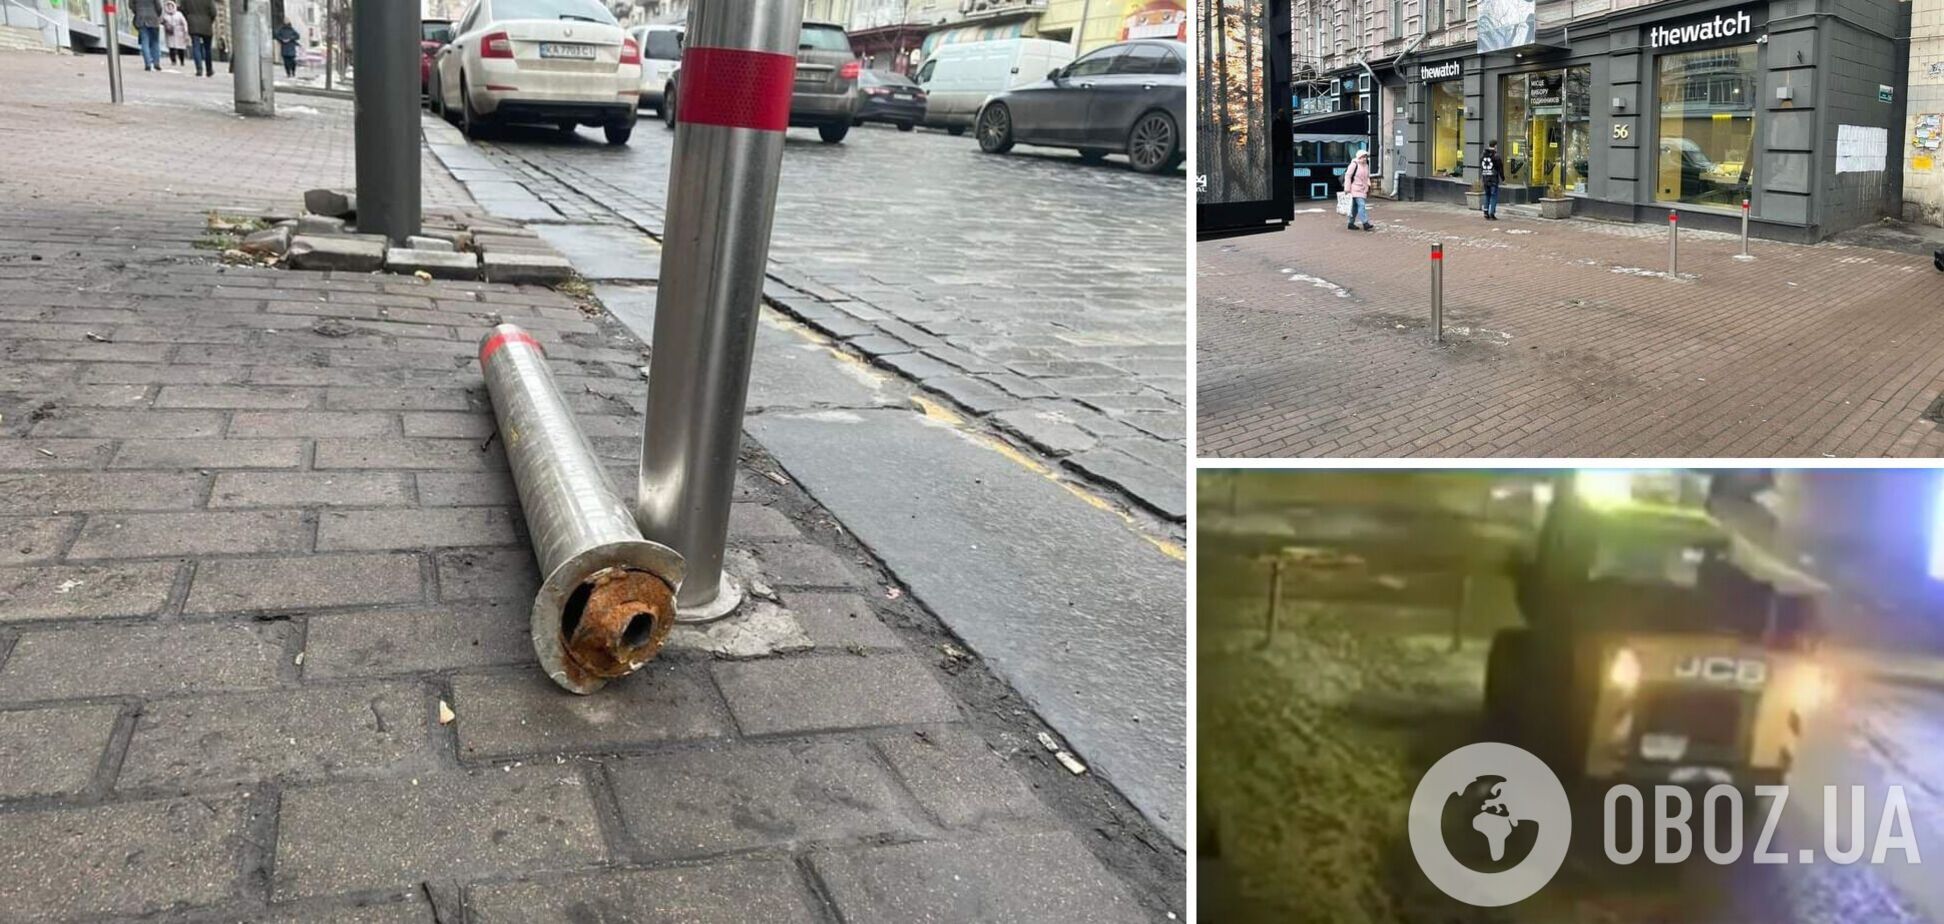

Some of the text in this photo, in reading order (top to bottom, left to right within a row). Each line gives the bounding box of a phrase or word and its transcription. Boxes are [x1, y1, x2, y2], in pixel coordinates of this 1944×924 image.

[1650, 11, 1751, 48] thewatch
[1421, 60, 1460, 80] thewatch
[1613, 124, 1629, 139] 56
[1674, 656, 1766, 685] JCB
